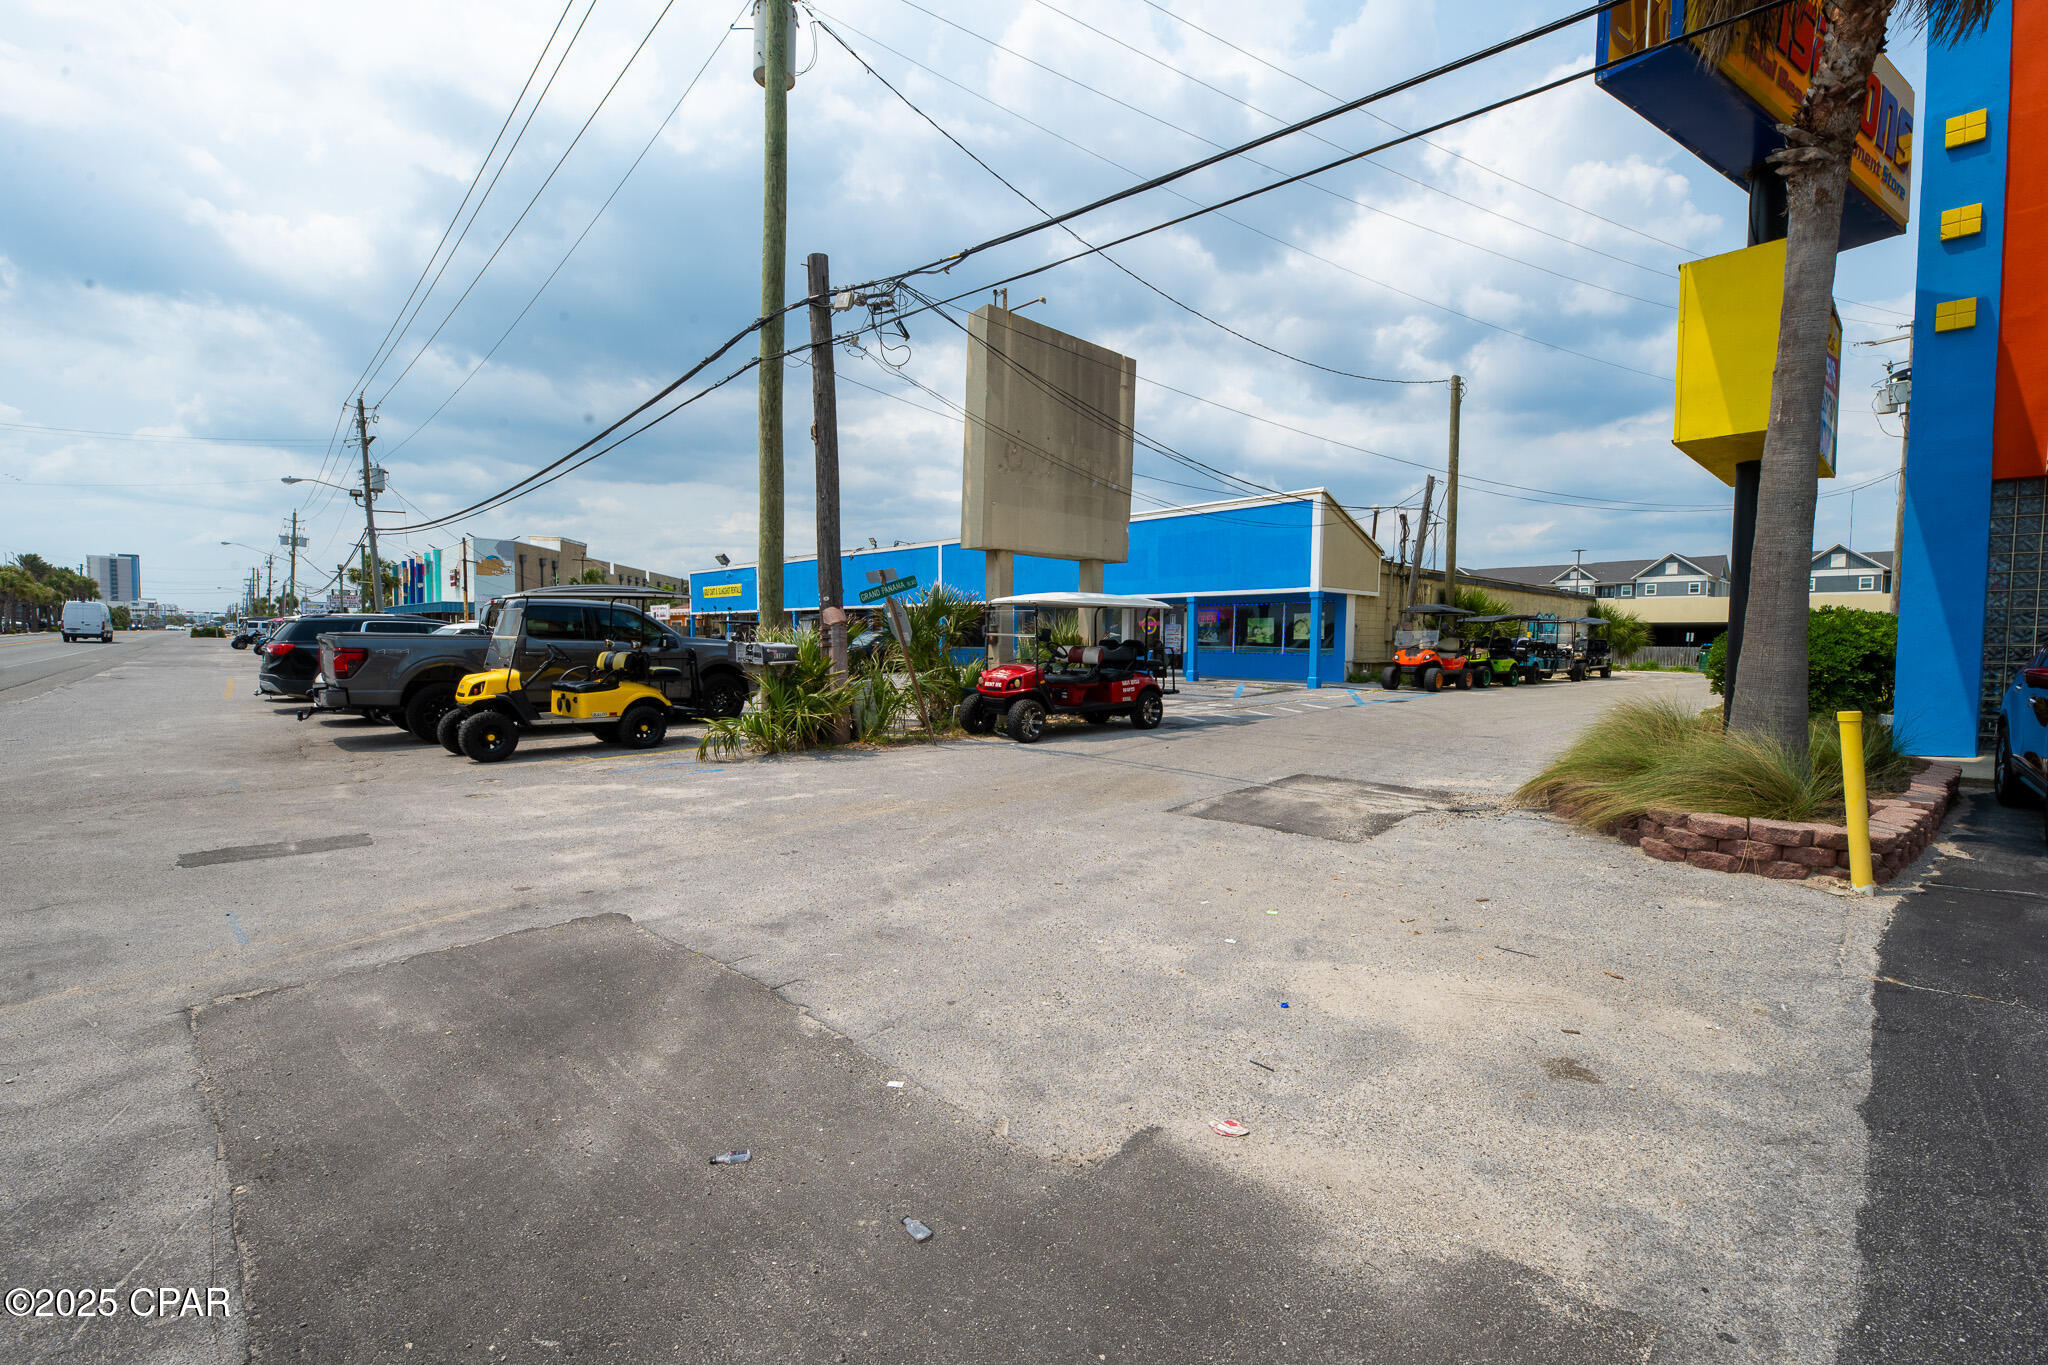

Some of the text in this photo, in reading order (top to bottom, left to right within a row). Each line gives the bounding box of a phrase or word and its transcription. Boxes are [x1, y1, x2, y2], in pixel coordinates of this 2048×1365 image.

[1881, 164, 1906, 200] Store
[860, 588, 881, 602] GRAND
[881, 581, 906, 596] PANAMA
